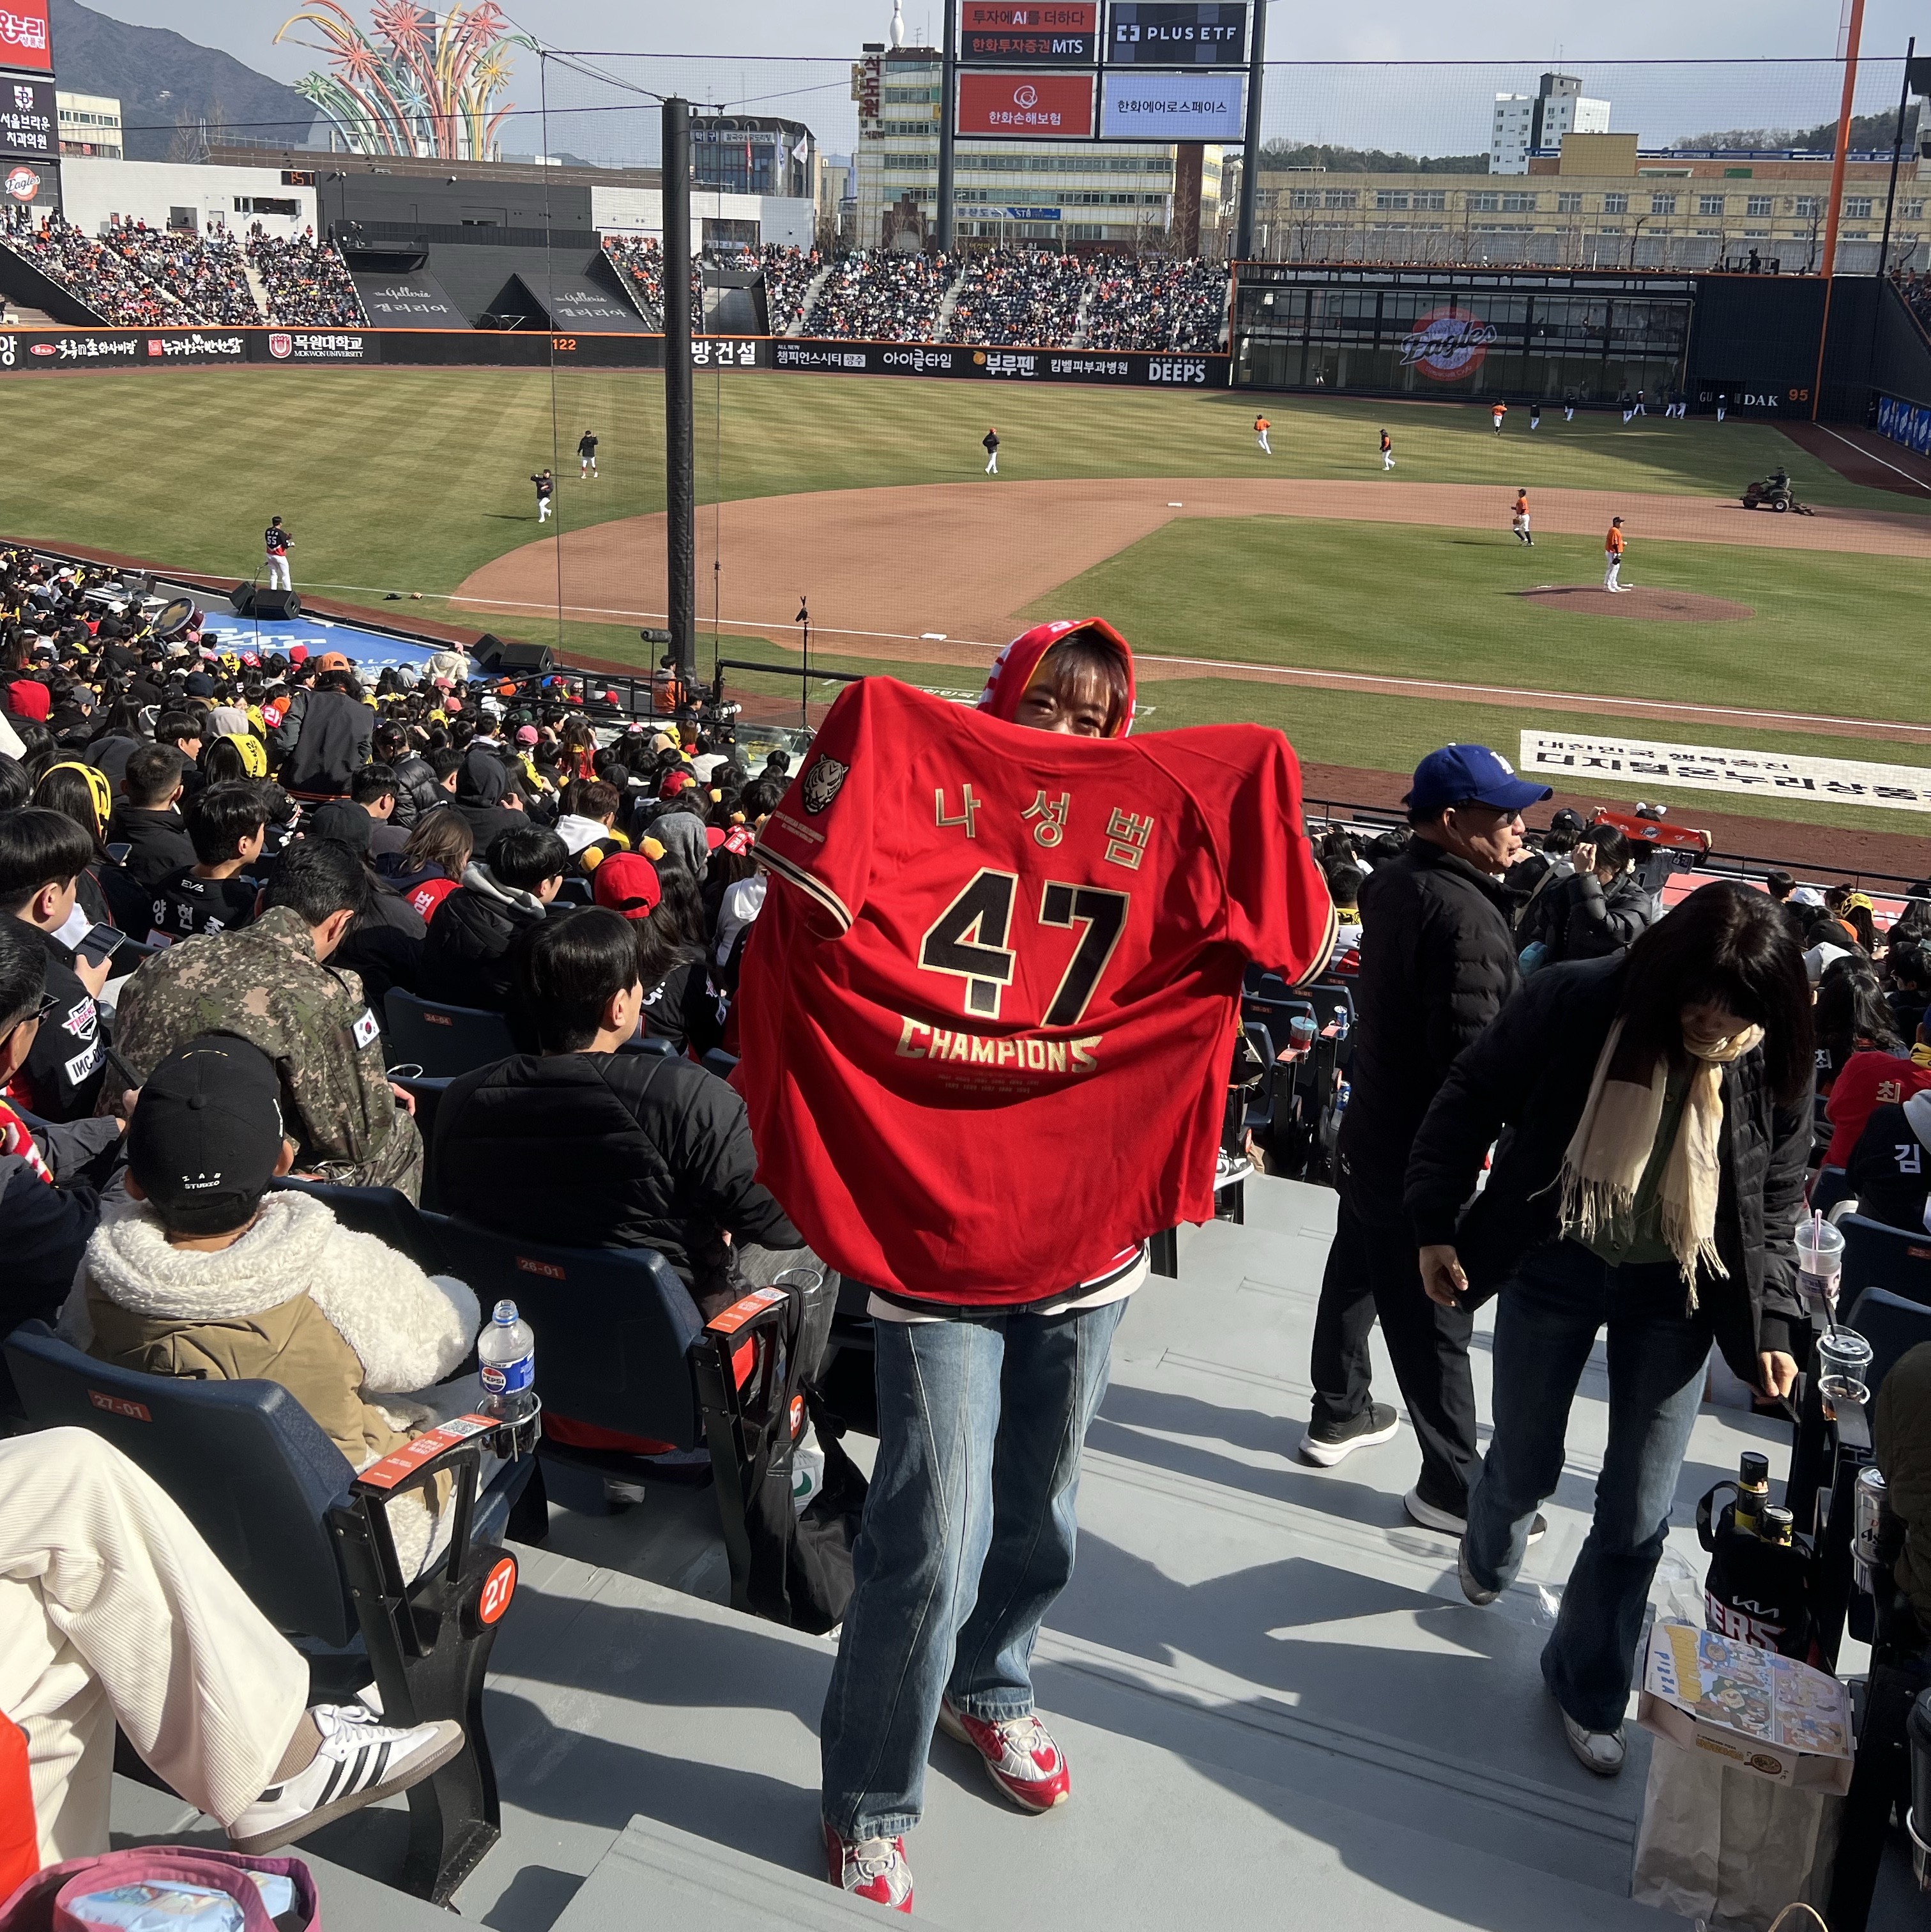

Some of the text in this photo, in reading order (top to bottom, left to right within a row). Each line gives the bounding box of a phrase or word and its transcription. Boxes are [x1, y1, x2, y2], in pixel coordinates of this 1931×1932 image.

[1044, 10, 1085, 26] 더하다
[1147, 27, 1237, 40] PLUS ETF
[1052, 39, 1084, 54] MTS
[1117, 100, 1228, 114] 한화에어로스페이스
[1, 112, 51, 132] 서울브라운
[989, 111, 1062, 126] 한화손해보험
[6, 132, 48, 150] 치과의원
[5, 175, 40, 194] Eagles
[386, 286, 431, 300] Galleria
[293, 334, 363, 351] 목원대학교
[552, 338, 577, 351] 122
[1400, 319, 1497, 366] Eagles
[691, 341, 756, 365] 방건설
[777, 351, 865, 367] 챔피언스시티 광주
[986, 354, 1035, 376] 부루펜
[1149, 362, 1206, 383] DEEPS
[1789, 388, 1809, 401] 95
[267, 535, 277, 545] 55
[1538, 740, 1656, 758] 대한민국
[1536, 751, 1931, 802] 디지털온누리상품
[935, 783, 1154, 871] 나성범
[917, 866, 1131, 1029] 47
[895, 1015, 1104, 1074] CHAMPIONS
[1875, 1080, 1902, 1105] 최
[1894, 1144, 1921, 1174] 김
[185, 1180, 220, 1190] STUDIO
[521, 1260, 560, 1278] 26-01
[483, 1373, 505, 1384] PEPSI
[93, 1393, 142, 1419] 27-01
[485, 1567, 512, 1614] 27
[1705, 1588, 1788, 1653] ERS
